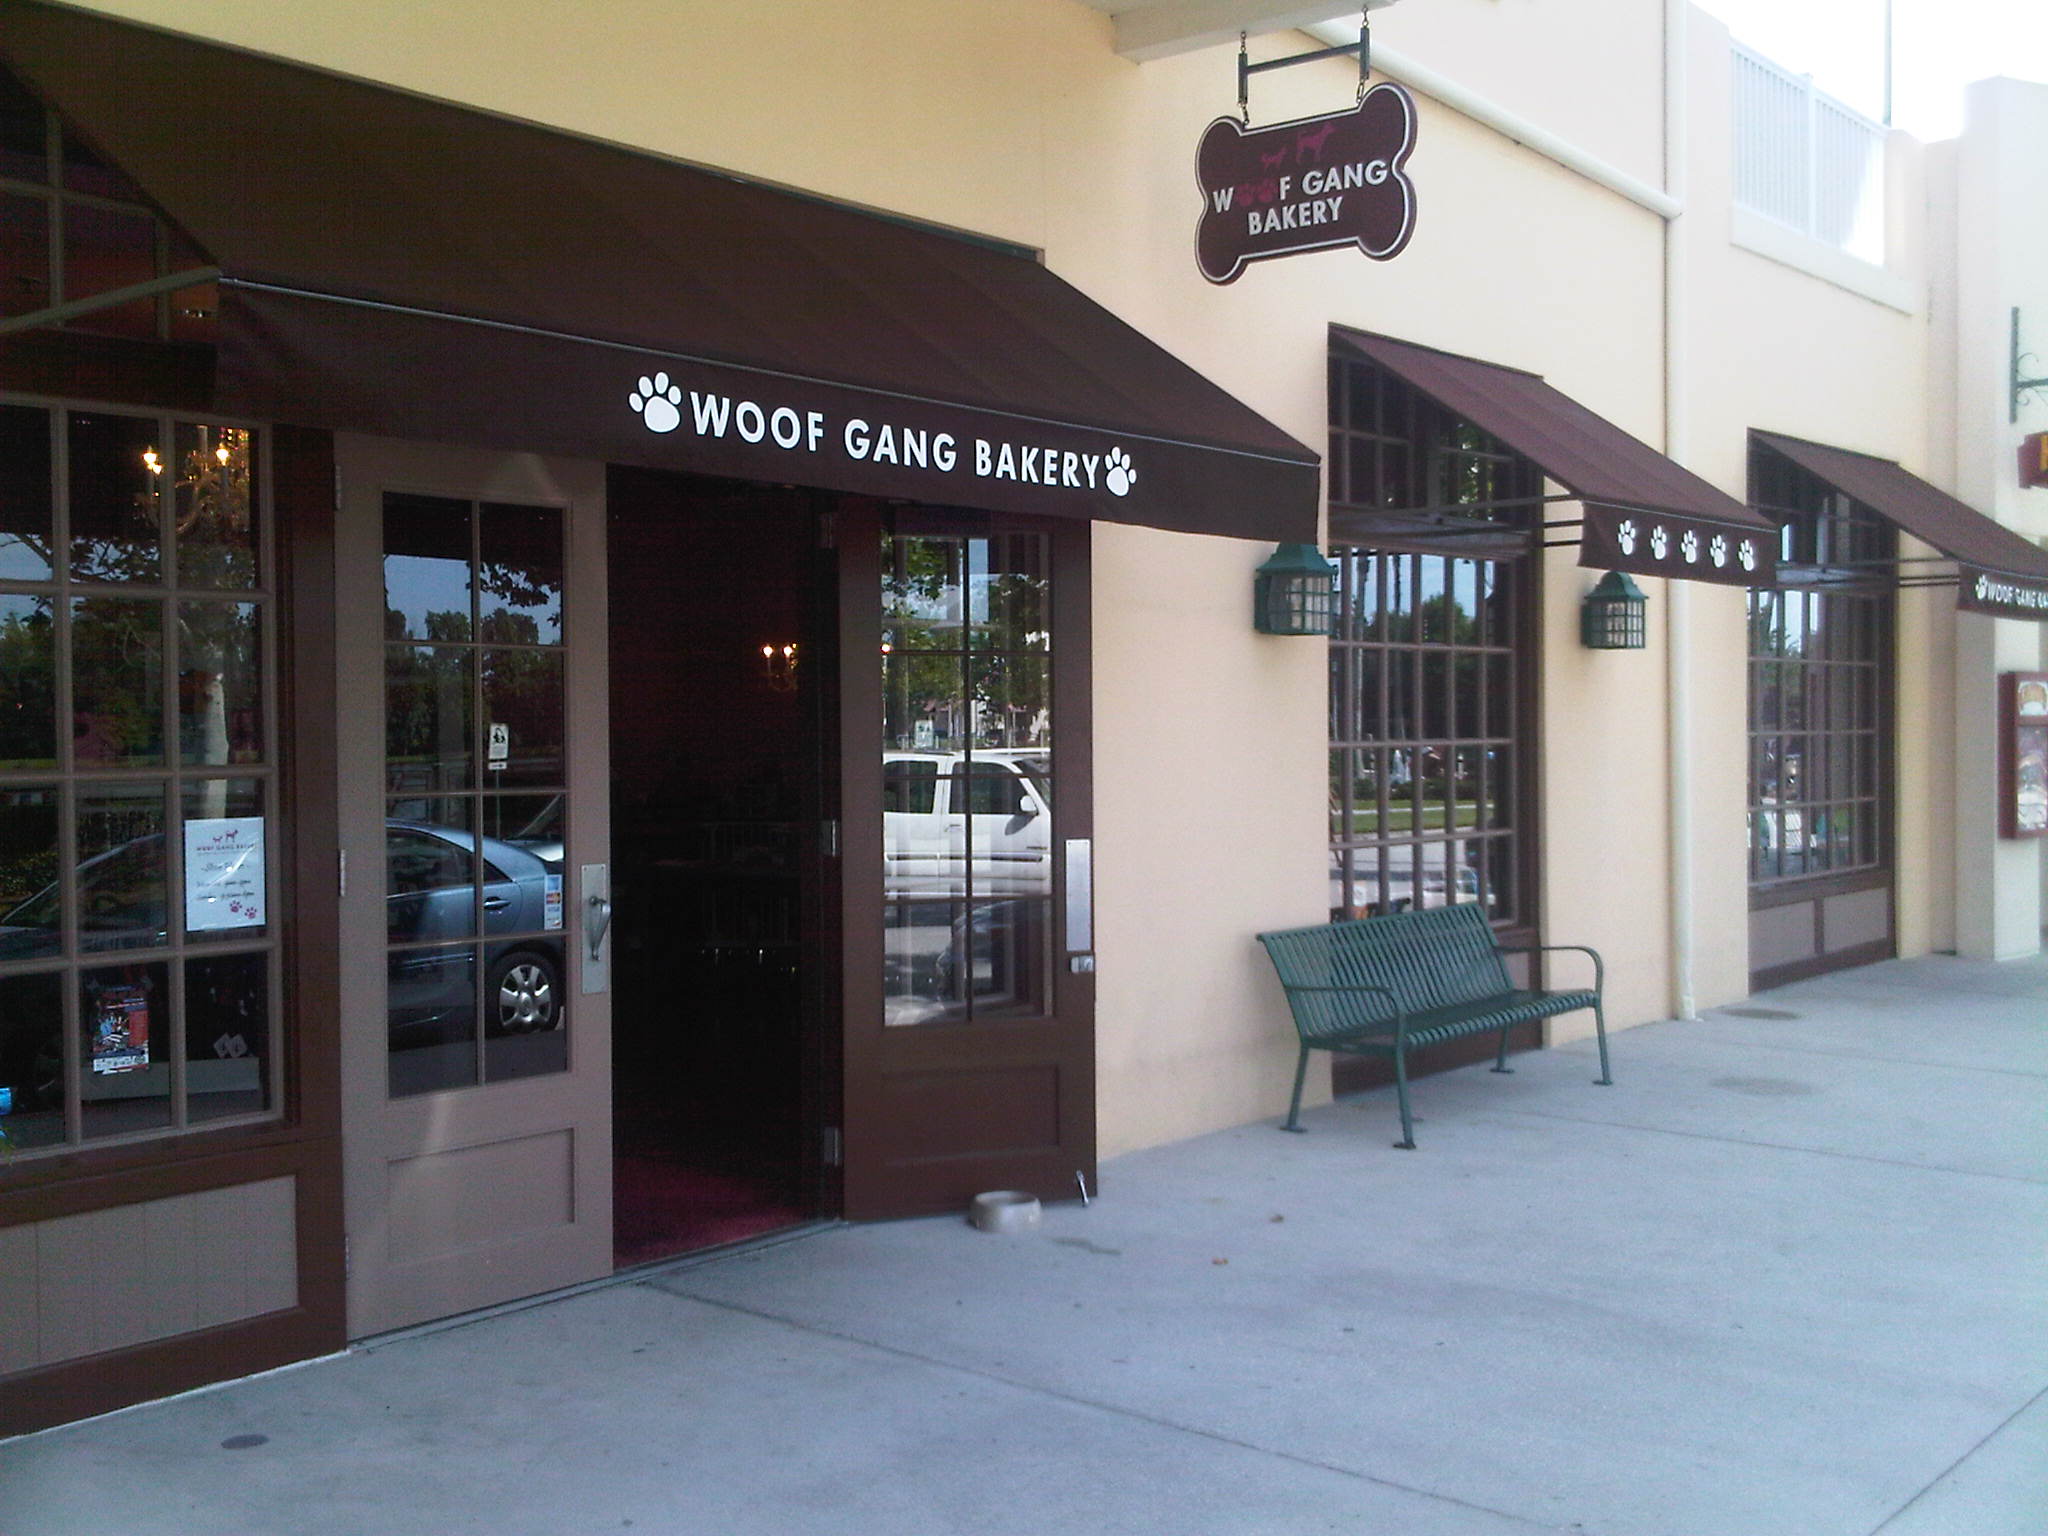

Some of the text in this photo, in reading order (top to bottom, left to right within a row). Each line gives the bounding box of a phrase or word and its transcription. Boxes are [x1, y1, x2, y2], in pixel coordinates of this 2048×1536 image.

[1302, 160, 1388, 195] GANG
[1248, 196, 1343, 235] BAKERY
[690, 391, 1101, 489] WOOF GANG BAKERY
[1987, 583, 2013, 603] WOOF
